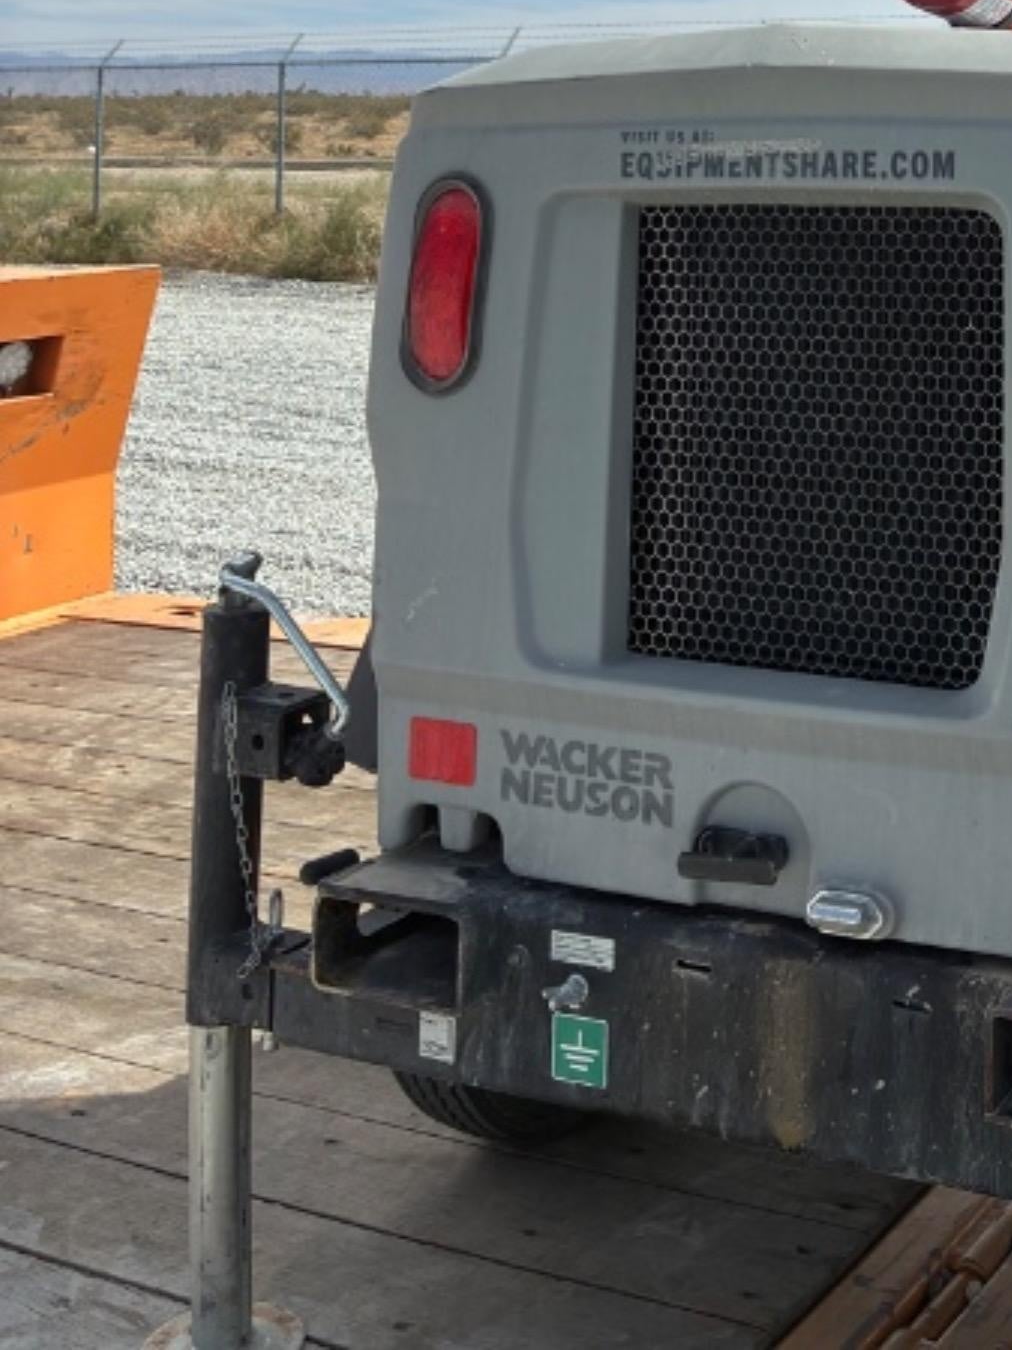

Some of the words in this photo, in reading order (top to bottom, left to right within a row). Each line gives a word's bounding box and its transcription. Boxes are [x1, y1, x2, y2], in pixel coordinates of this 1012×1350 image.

[620, 130, 659, 143] VISIT
[665, 130, 685, 144] US
[501, 728, 674, 790] WACKER
[501, 767, 674, 828] NEUSON
